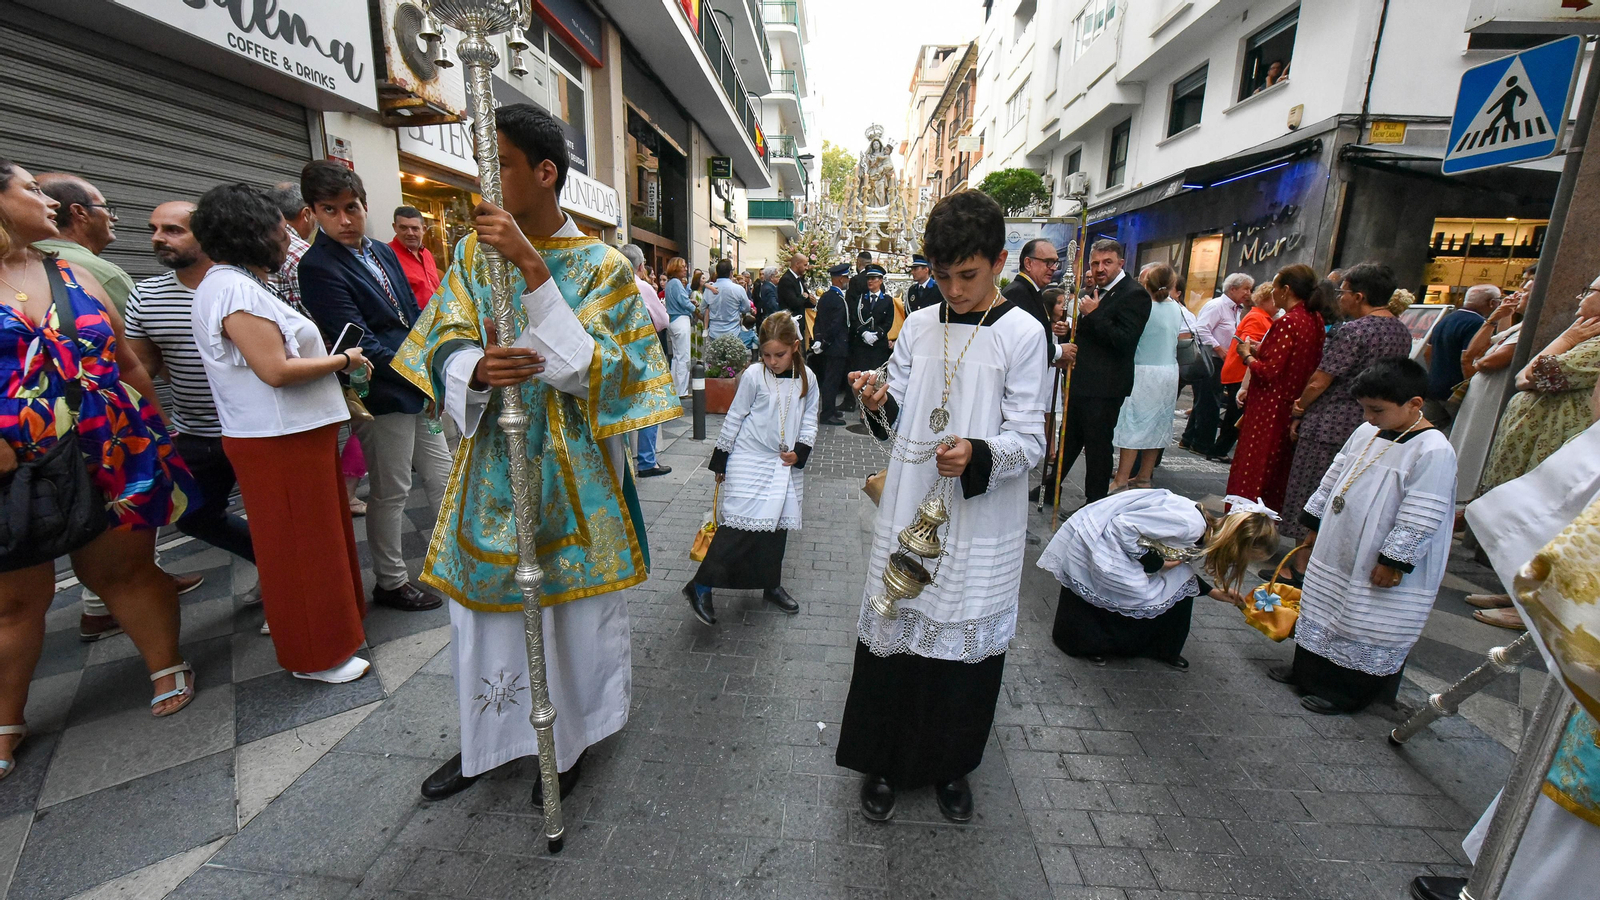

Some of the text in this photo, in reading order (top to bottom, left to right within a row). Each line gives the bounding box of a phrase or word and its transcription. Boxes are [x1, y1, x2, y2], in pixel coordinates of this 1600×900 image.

[182, 0, 364, 84] alma
[227, 31, 336, 91] COFFEE & DRINKS
[564, 174, 615, 218] PUNTADAS
[1238, 229, 1305, 268] Mare
[483, 683, 517, 703] JHS
